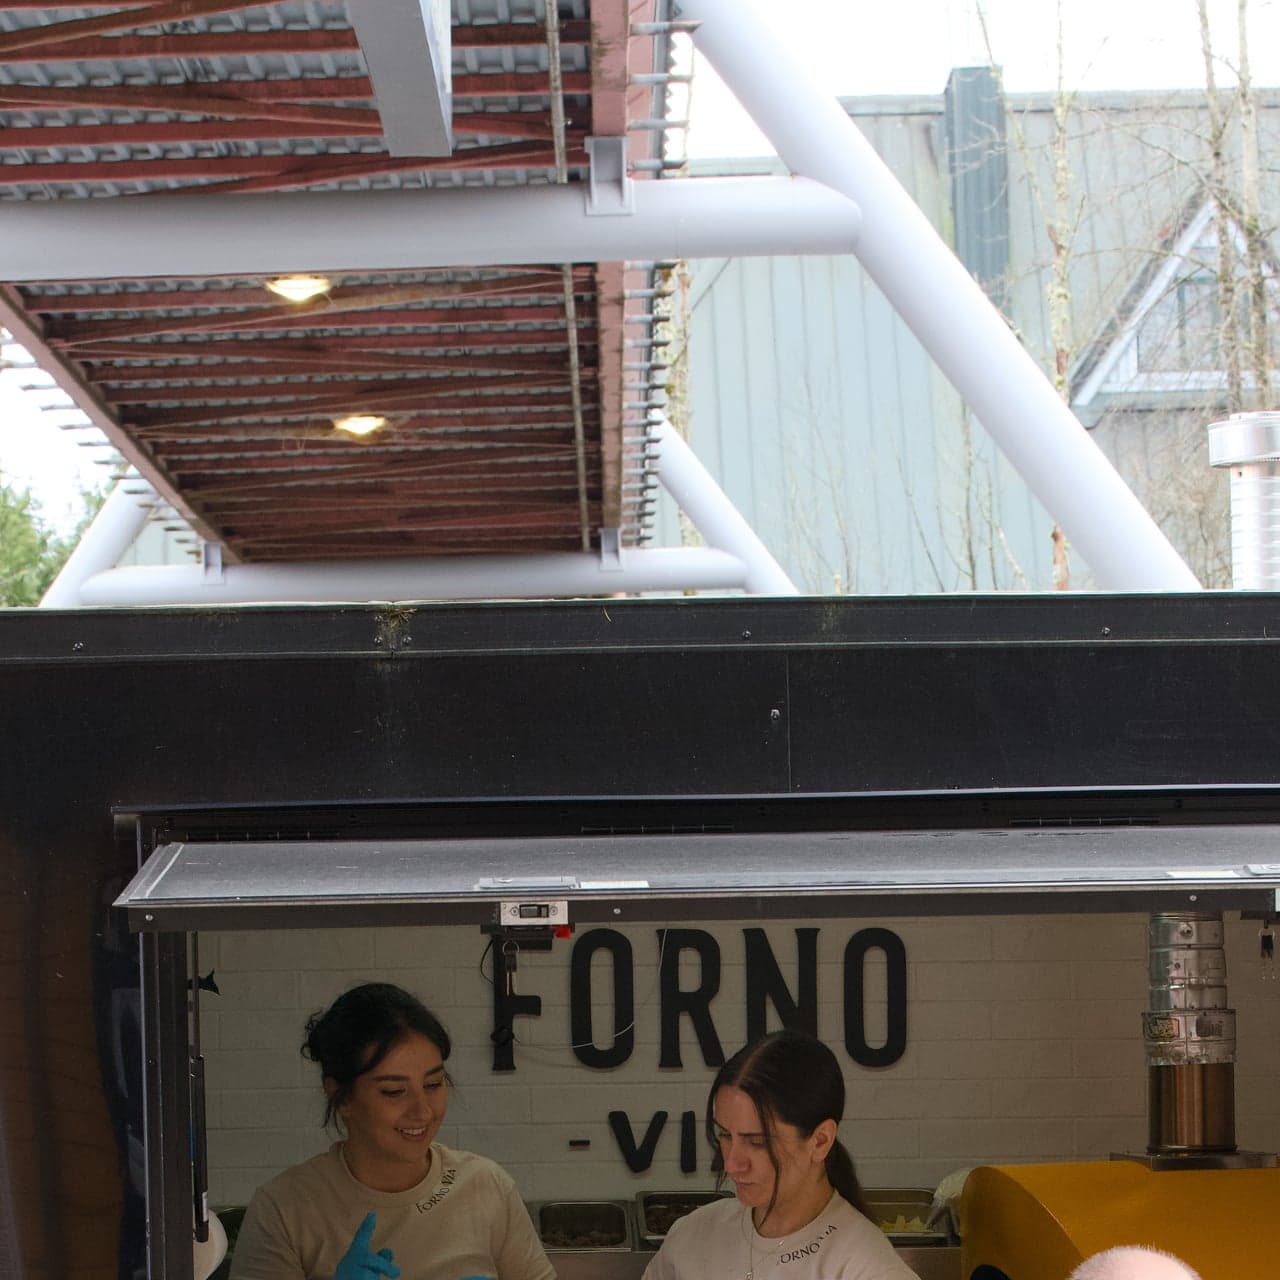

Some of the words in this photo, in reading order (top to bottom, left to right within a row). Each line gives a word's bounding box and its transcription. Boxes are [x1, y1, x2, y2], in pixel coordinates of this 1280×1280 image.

[492, 928, 908, 1071] FORNO
[569, 1110, 723, 1173] -VI
[778, 1242, 820, 1264] ORNO
